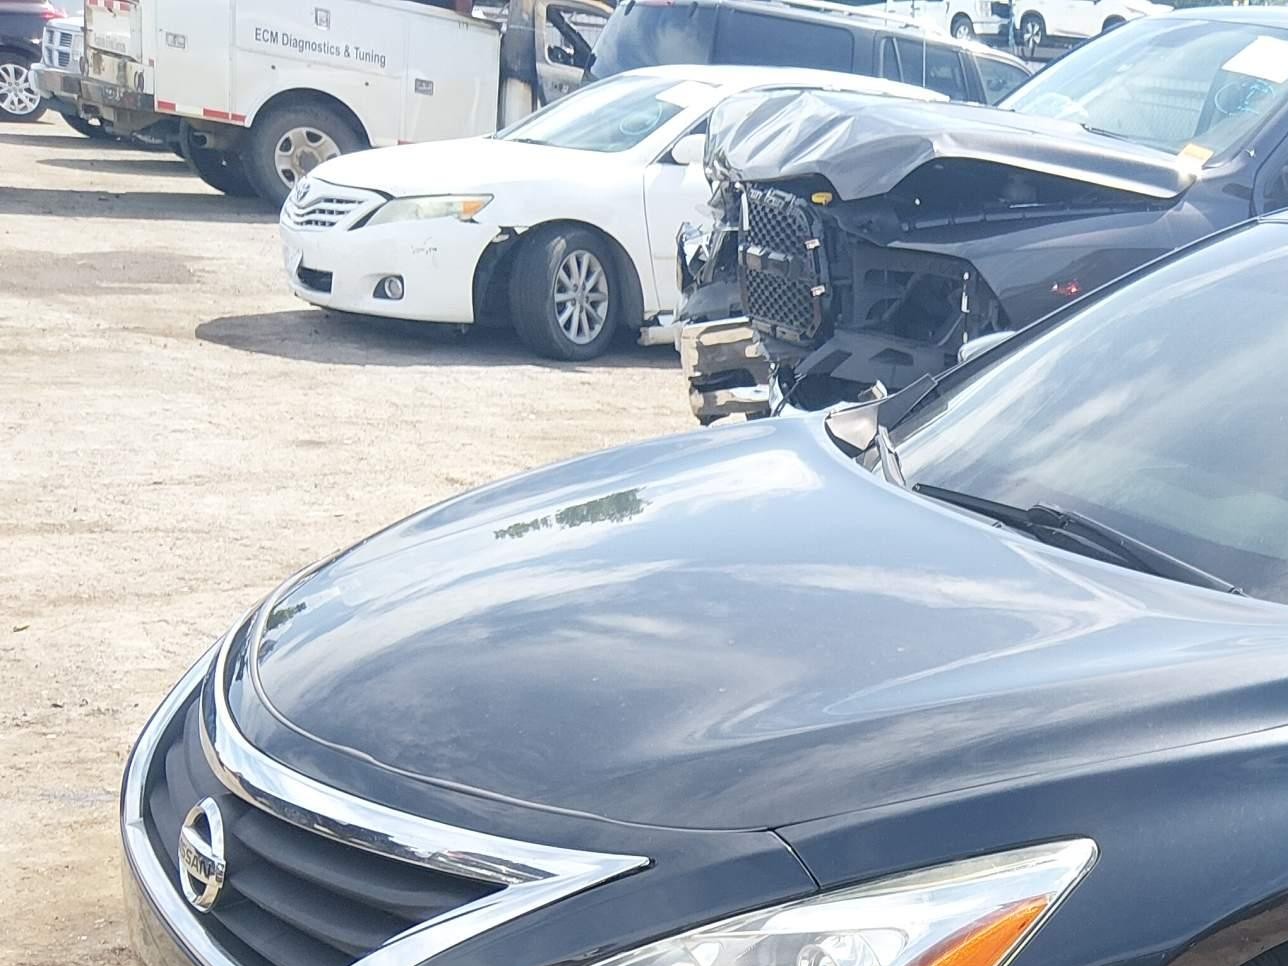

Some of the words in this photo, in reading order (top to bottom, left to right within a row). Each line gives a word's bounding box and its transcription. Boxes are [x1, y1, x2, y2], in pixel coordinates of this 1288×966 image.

[254, 27, 279, 46] ECM
[281, 33, 341, 57] Diagnostics
[343, 45, 352, 58] &
[354, 46, 387, 68] Tuning
